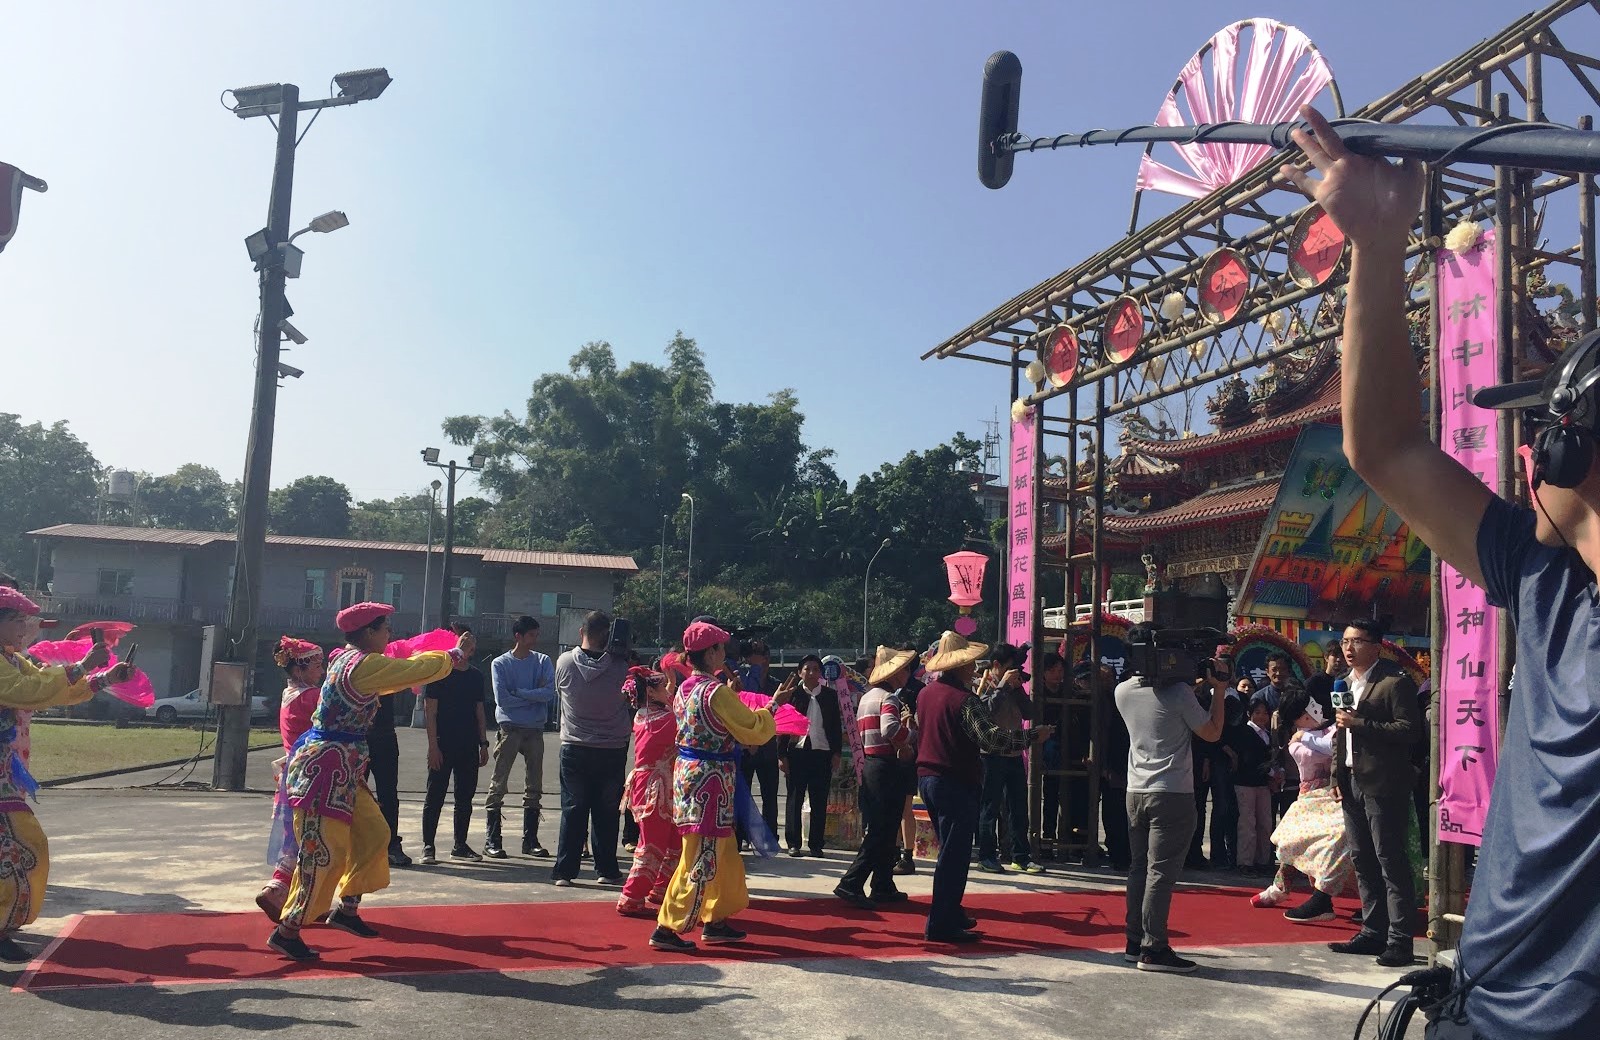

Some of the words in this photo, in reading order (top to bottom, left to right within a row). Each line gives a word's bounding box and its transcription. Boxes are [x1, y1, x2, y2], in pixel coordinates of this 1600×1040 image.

[1011, 445, 1029, 648] 王城並蒂花盛開
